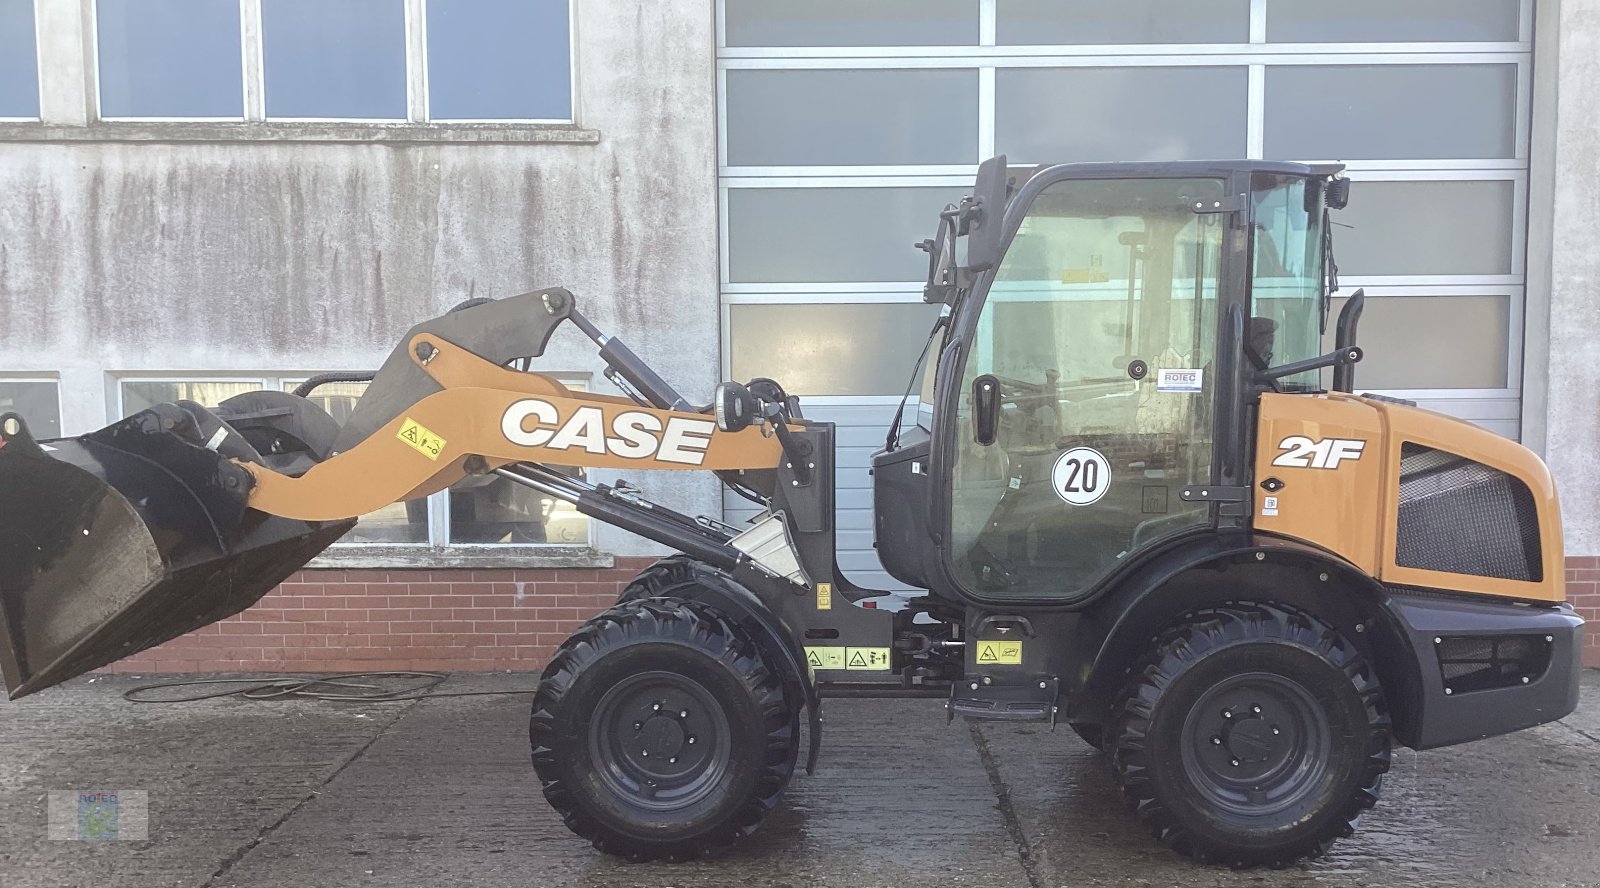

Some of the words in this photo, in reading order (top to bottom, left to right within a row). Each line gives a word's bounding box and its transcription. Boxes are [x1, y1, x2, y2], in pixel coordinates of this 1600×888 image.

[1165, 373, 1196, 382] ROTEC
[501, 398, 716, 465] CASE
[1271, 435, 1367, 470] 21F
[1064, 458, 1098, 492] 20
